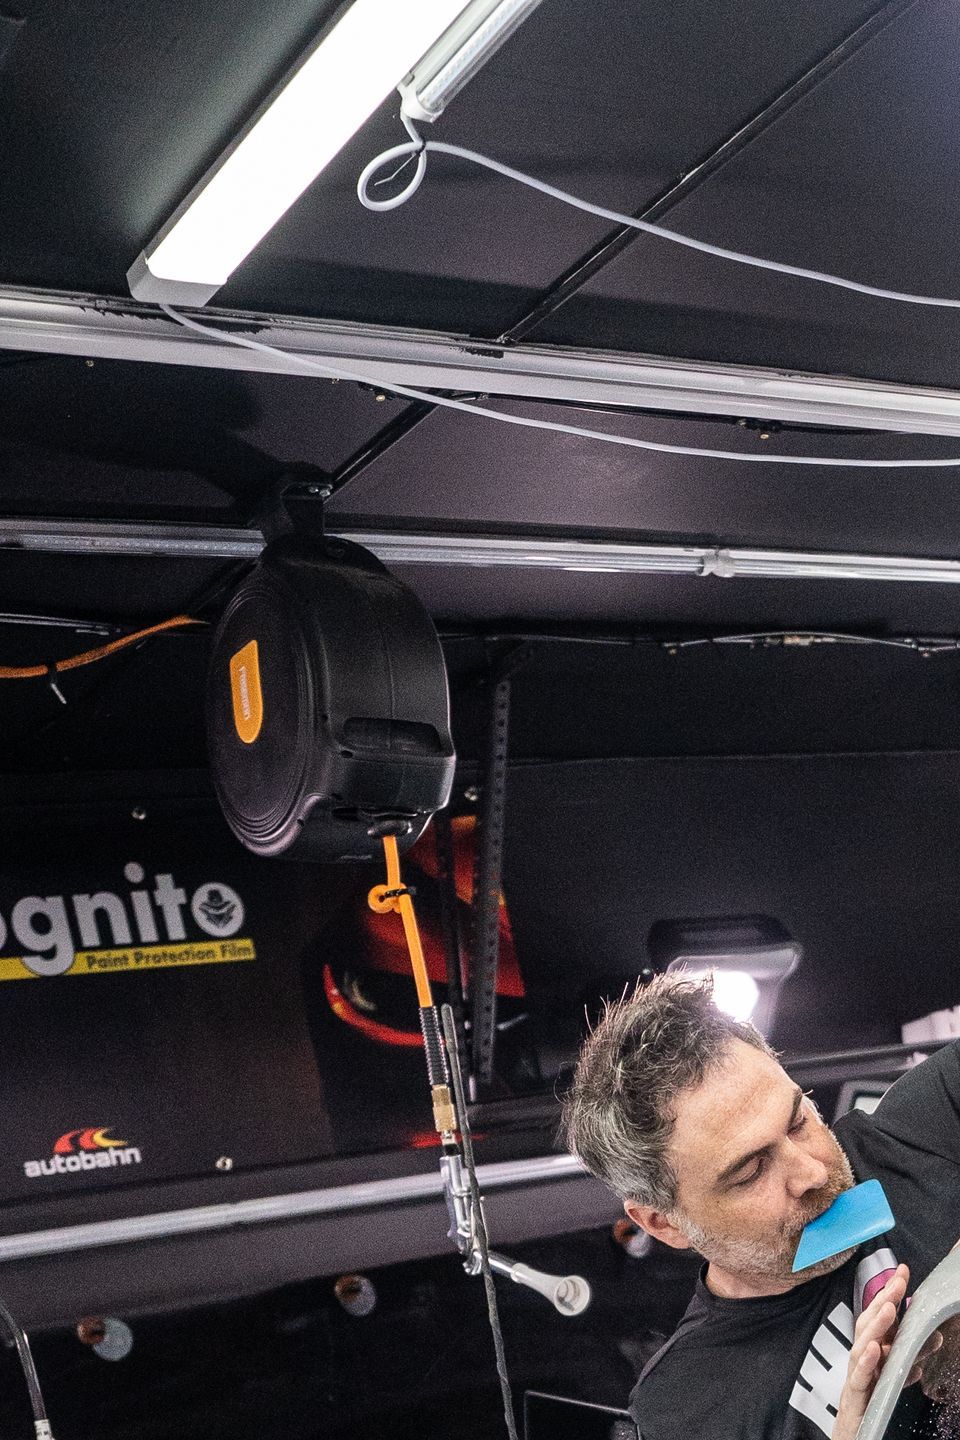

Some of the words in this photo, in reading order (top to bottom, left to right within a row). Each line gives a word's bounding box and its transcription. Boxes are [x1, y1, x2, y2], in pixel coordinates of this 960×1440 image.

[0, 861, 245, 977] gnito
[86, 952, 129, 970] Paint
[134, 947, 216, 966] Protection
[220, 942, 253, 958] Film
[23, 1147, 142, 1178] autobahn
